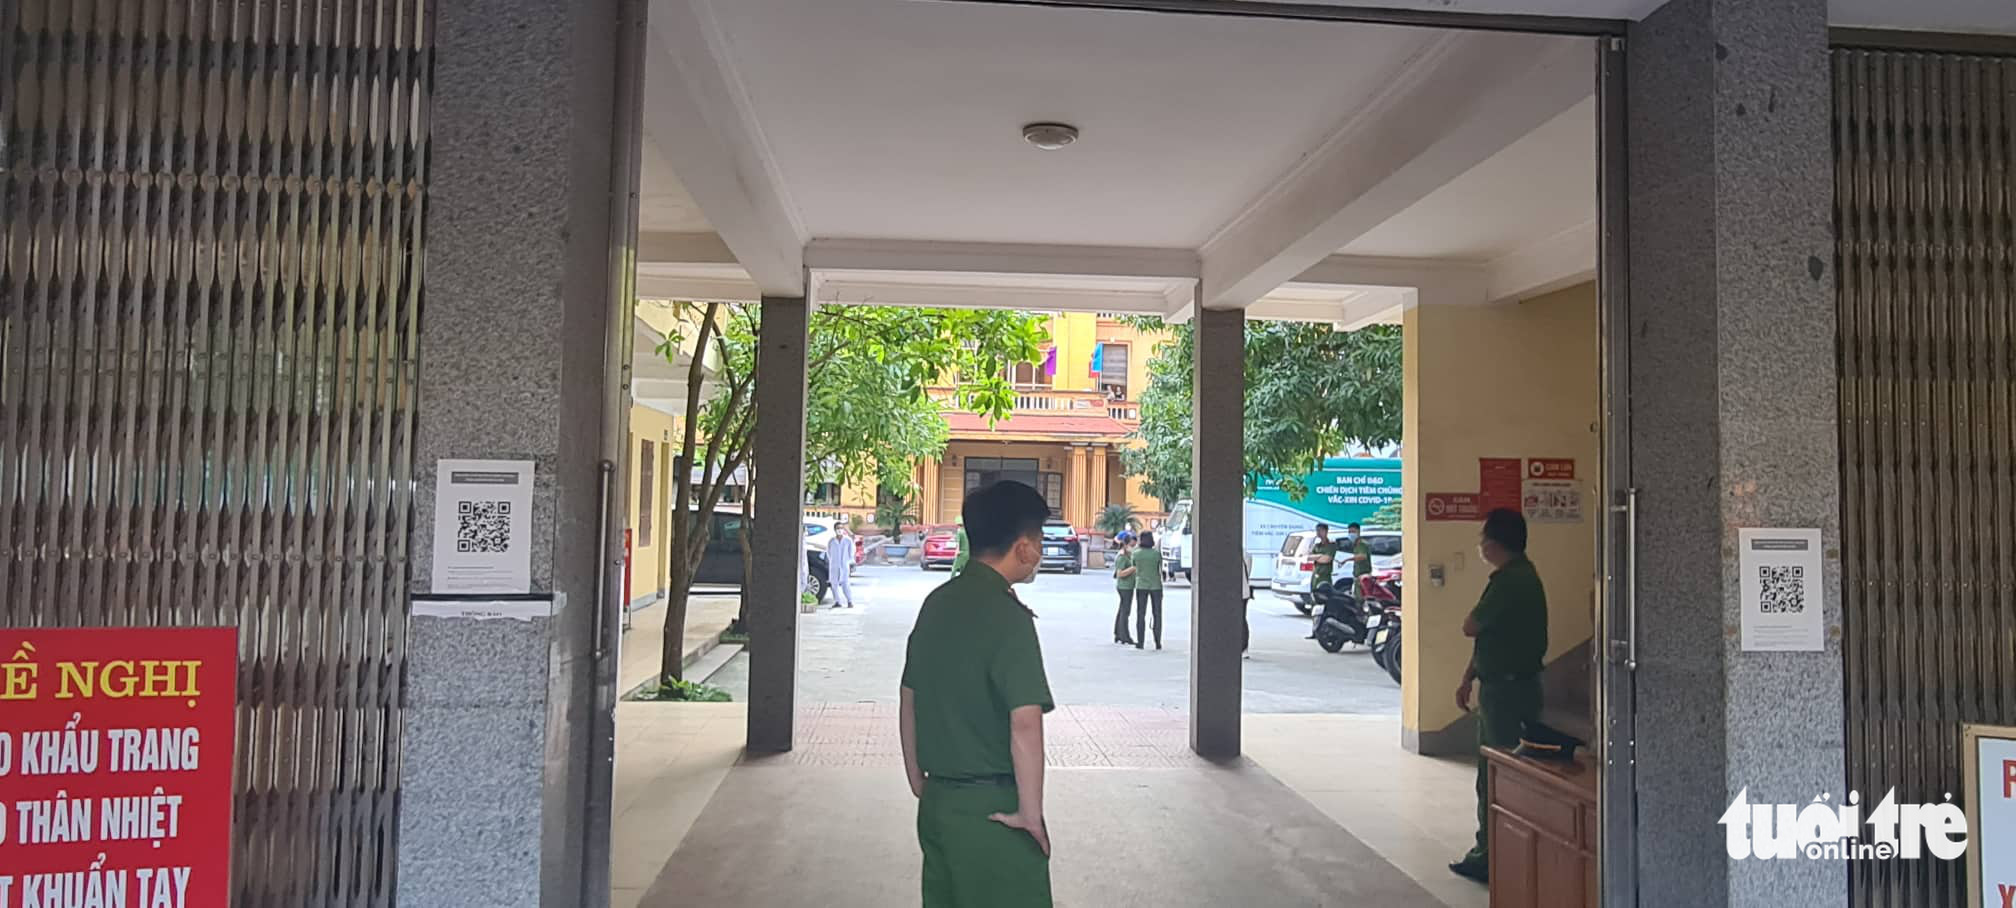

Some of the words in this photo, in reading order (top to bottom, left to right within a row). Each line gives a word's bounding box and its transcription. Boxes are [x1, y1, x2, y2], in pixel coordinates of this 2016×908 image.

[1336, 476, 1352, 484] BAN
[0, 641, 38, 699] Ề
[55, 660, 202, 708] NGHỊ
[20, 712, 100, 775] KHẨU
[107, 727, 201, 772] TRANG
[16, 790, 92, 844] THÂN
[100, 786, 183, 848] NHIỆT
[22, 852, 127, 908] KHUẨN
[136, 867, 192, 908] TAY
